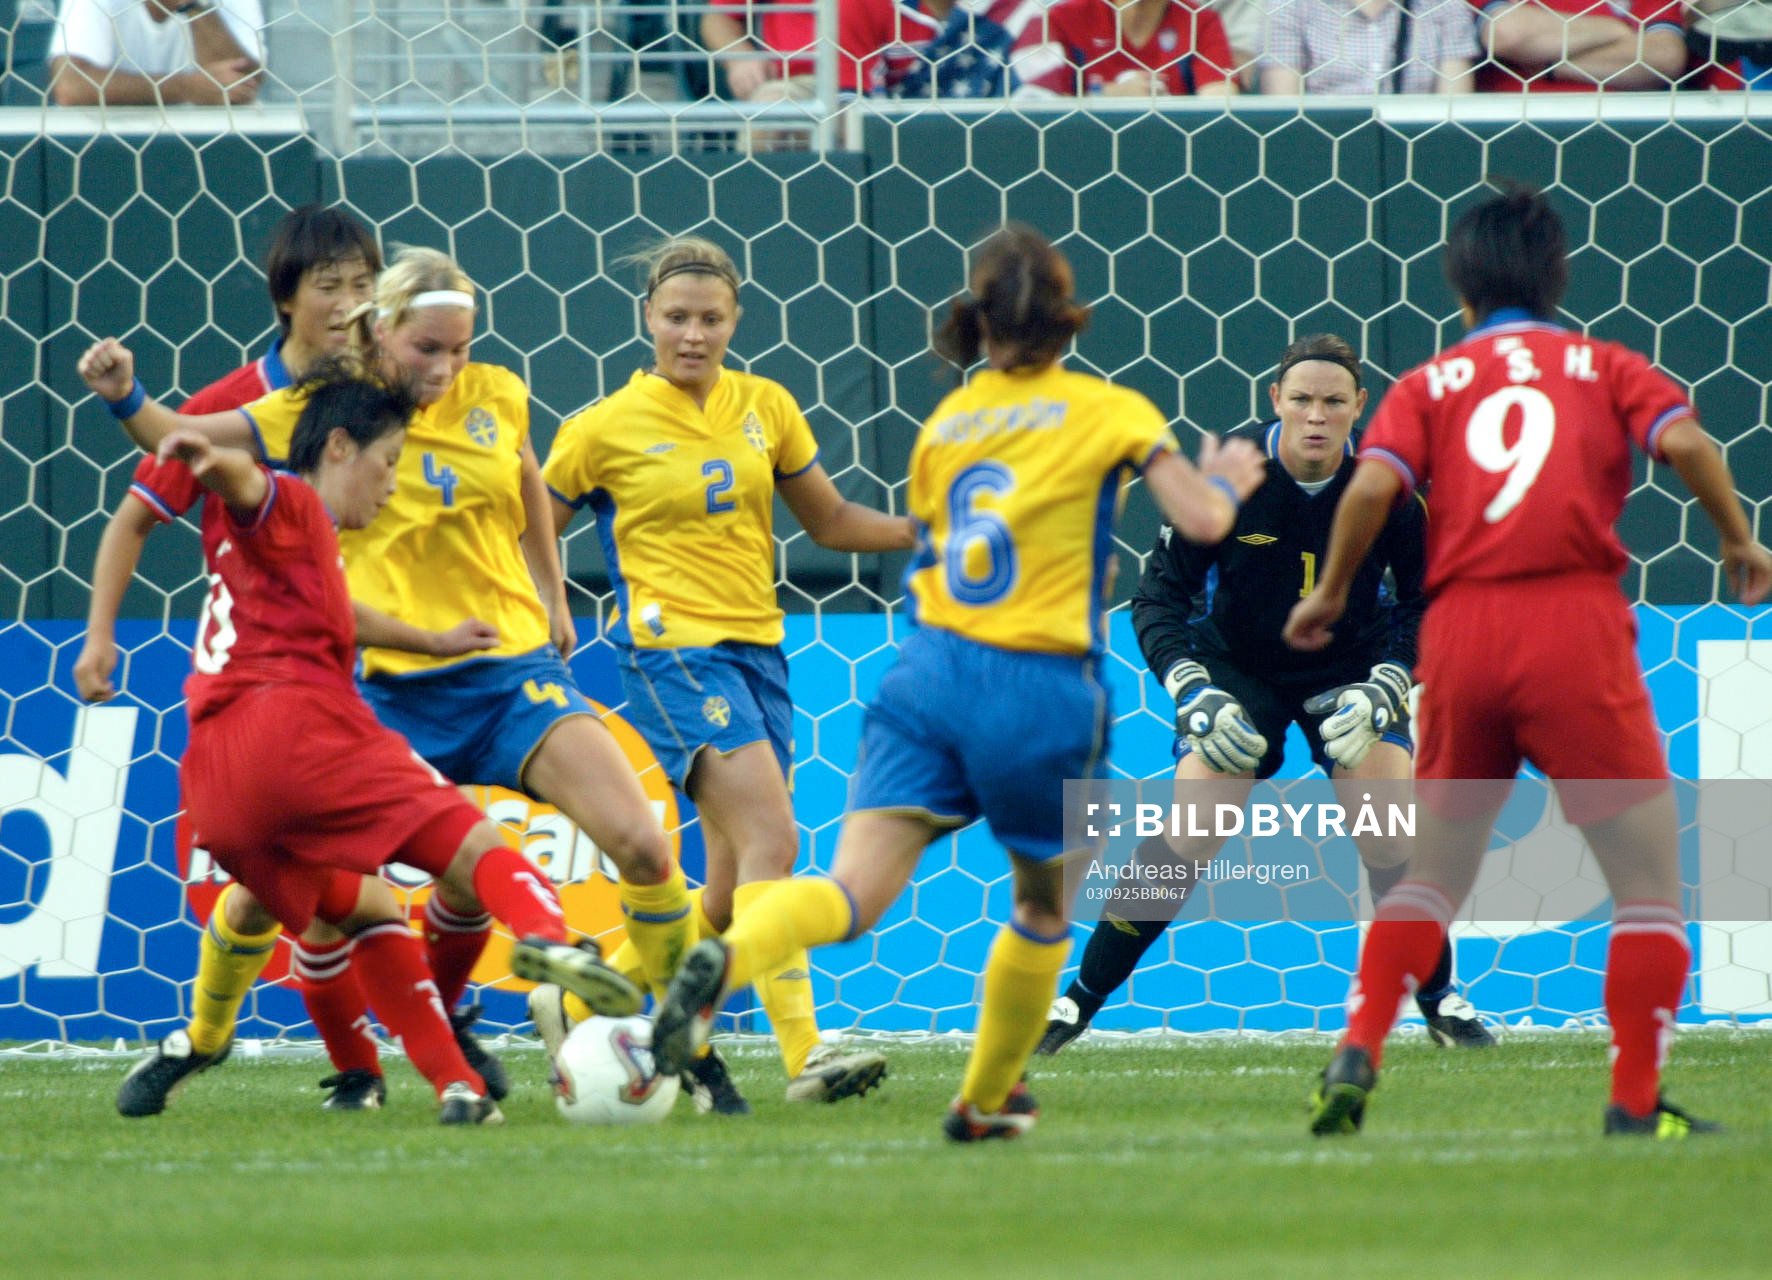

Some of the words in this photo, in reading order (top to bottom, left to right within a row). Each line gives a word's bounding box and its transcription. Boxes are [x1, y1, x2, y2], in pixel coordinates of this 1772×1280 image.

[422, 453, 458, 507] 4
[1465, 385, 1555, 524] 9
[702, 460, 735, 514] 2
[946, 459, 1016, 606] 6
[523, 679, 570, 709] 4
